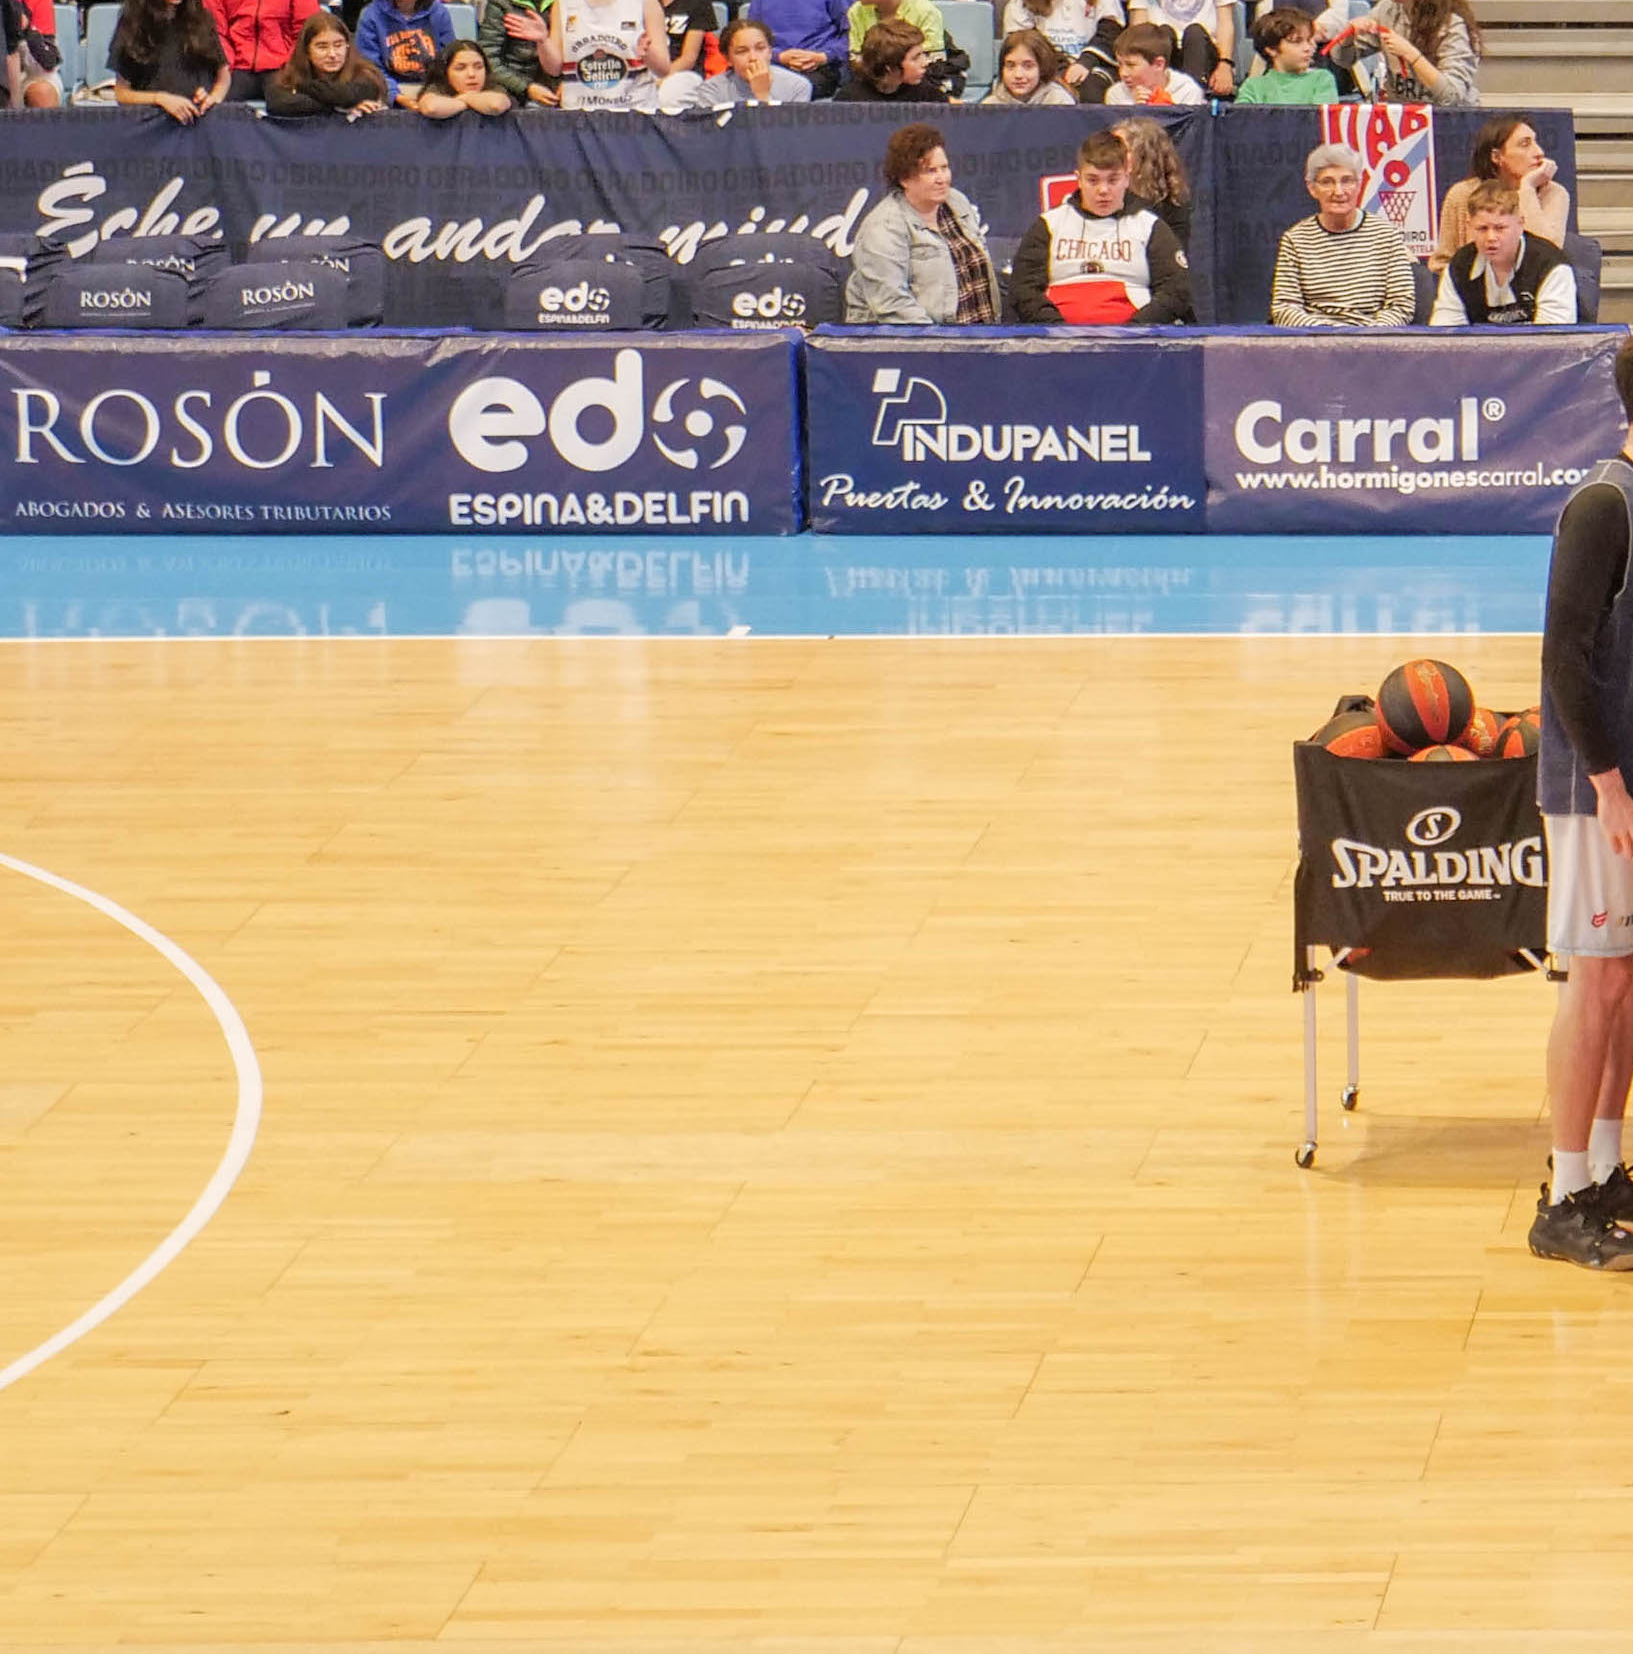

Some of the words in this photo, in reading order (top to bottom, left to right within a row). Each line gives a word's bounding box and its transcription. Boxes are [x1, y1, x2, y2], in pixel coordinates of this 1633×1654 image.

[1056, 238, 1133, 262] CHICAGO
[903, 424, 1151, 464] INDUPANEL
[820, 475, 948, 511] Puertas
[963, 479, 996, 512] &
[1004, 475, 1197, 514] Innovación
[15, 500, 126, 521] ABOGADOS
[136, 501, 152, 521] &
[162, 502, 254, 522] ASESORES
[259, 503, 393, 522] TRIBUTARIOS
[1331, 834, 1549, 889] SPALDING
[1383, 889, 1415, 902] TRUE
[1415, 889, 1433, 902] TO
[1433, 889, 1456, 902] THE
[1457, 889, 1492, 902] GAME
